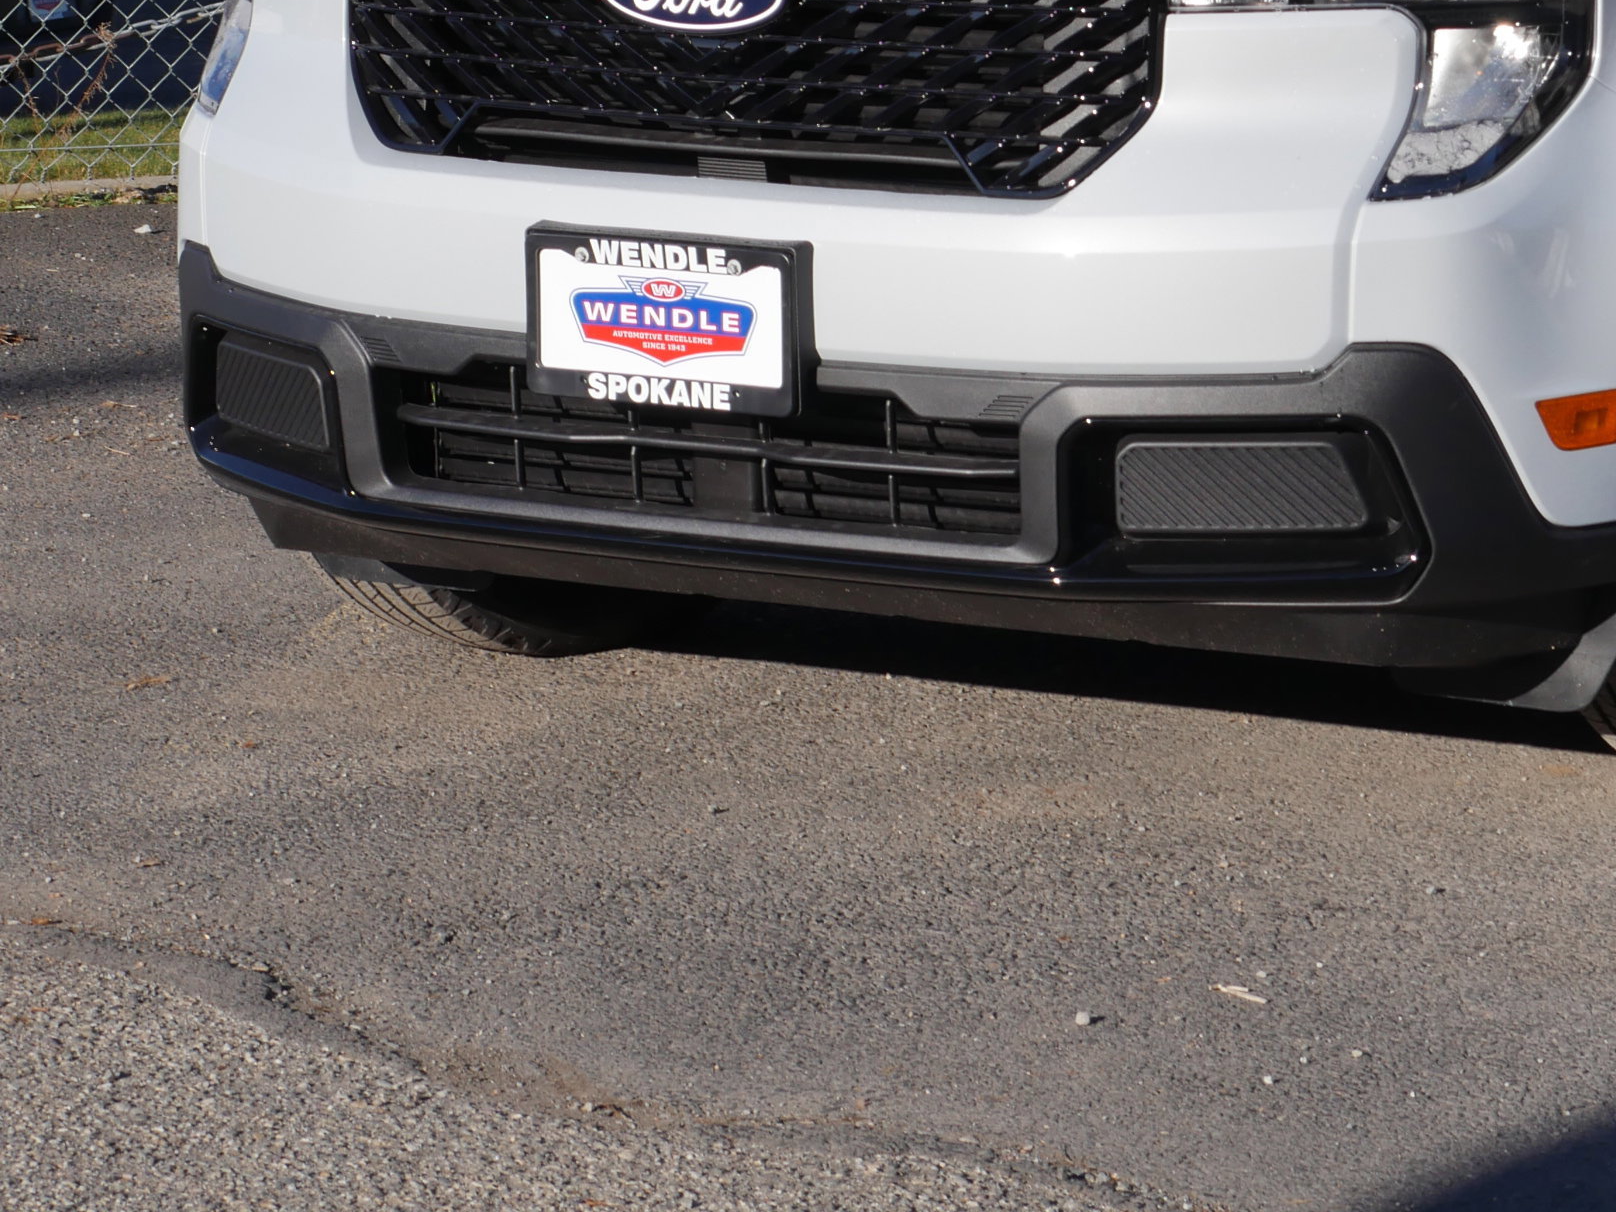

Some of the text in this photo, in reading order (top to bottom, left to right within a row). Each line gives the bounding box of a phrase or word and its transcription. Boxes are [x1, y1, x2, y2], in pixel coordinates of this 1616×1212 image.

[589, 238, 728, 275] WENDLE
[582, 301, 741, 333] WENDLE
[612, 330, 713, 345] AUTOMOTIVE EXCELLENCE
[642, 341, 686, 352] SINCE 1943
[587, 371, 731, 411] SPOKANE
